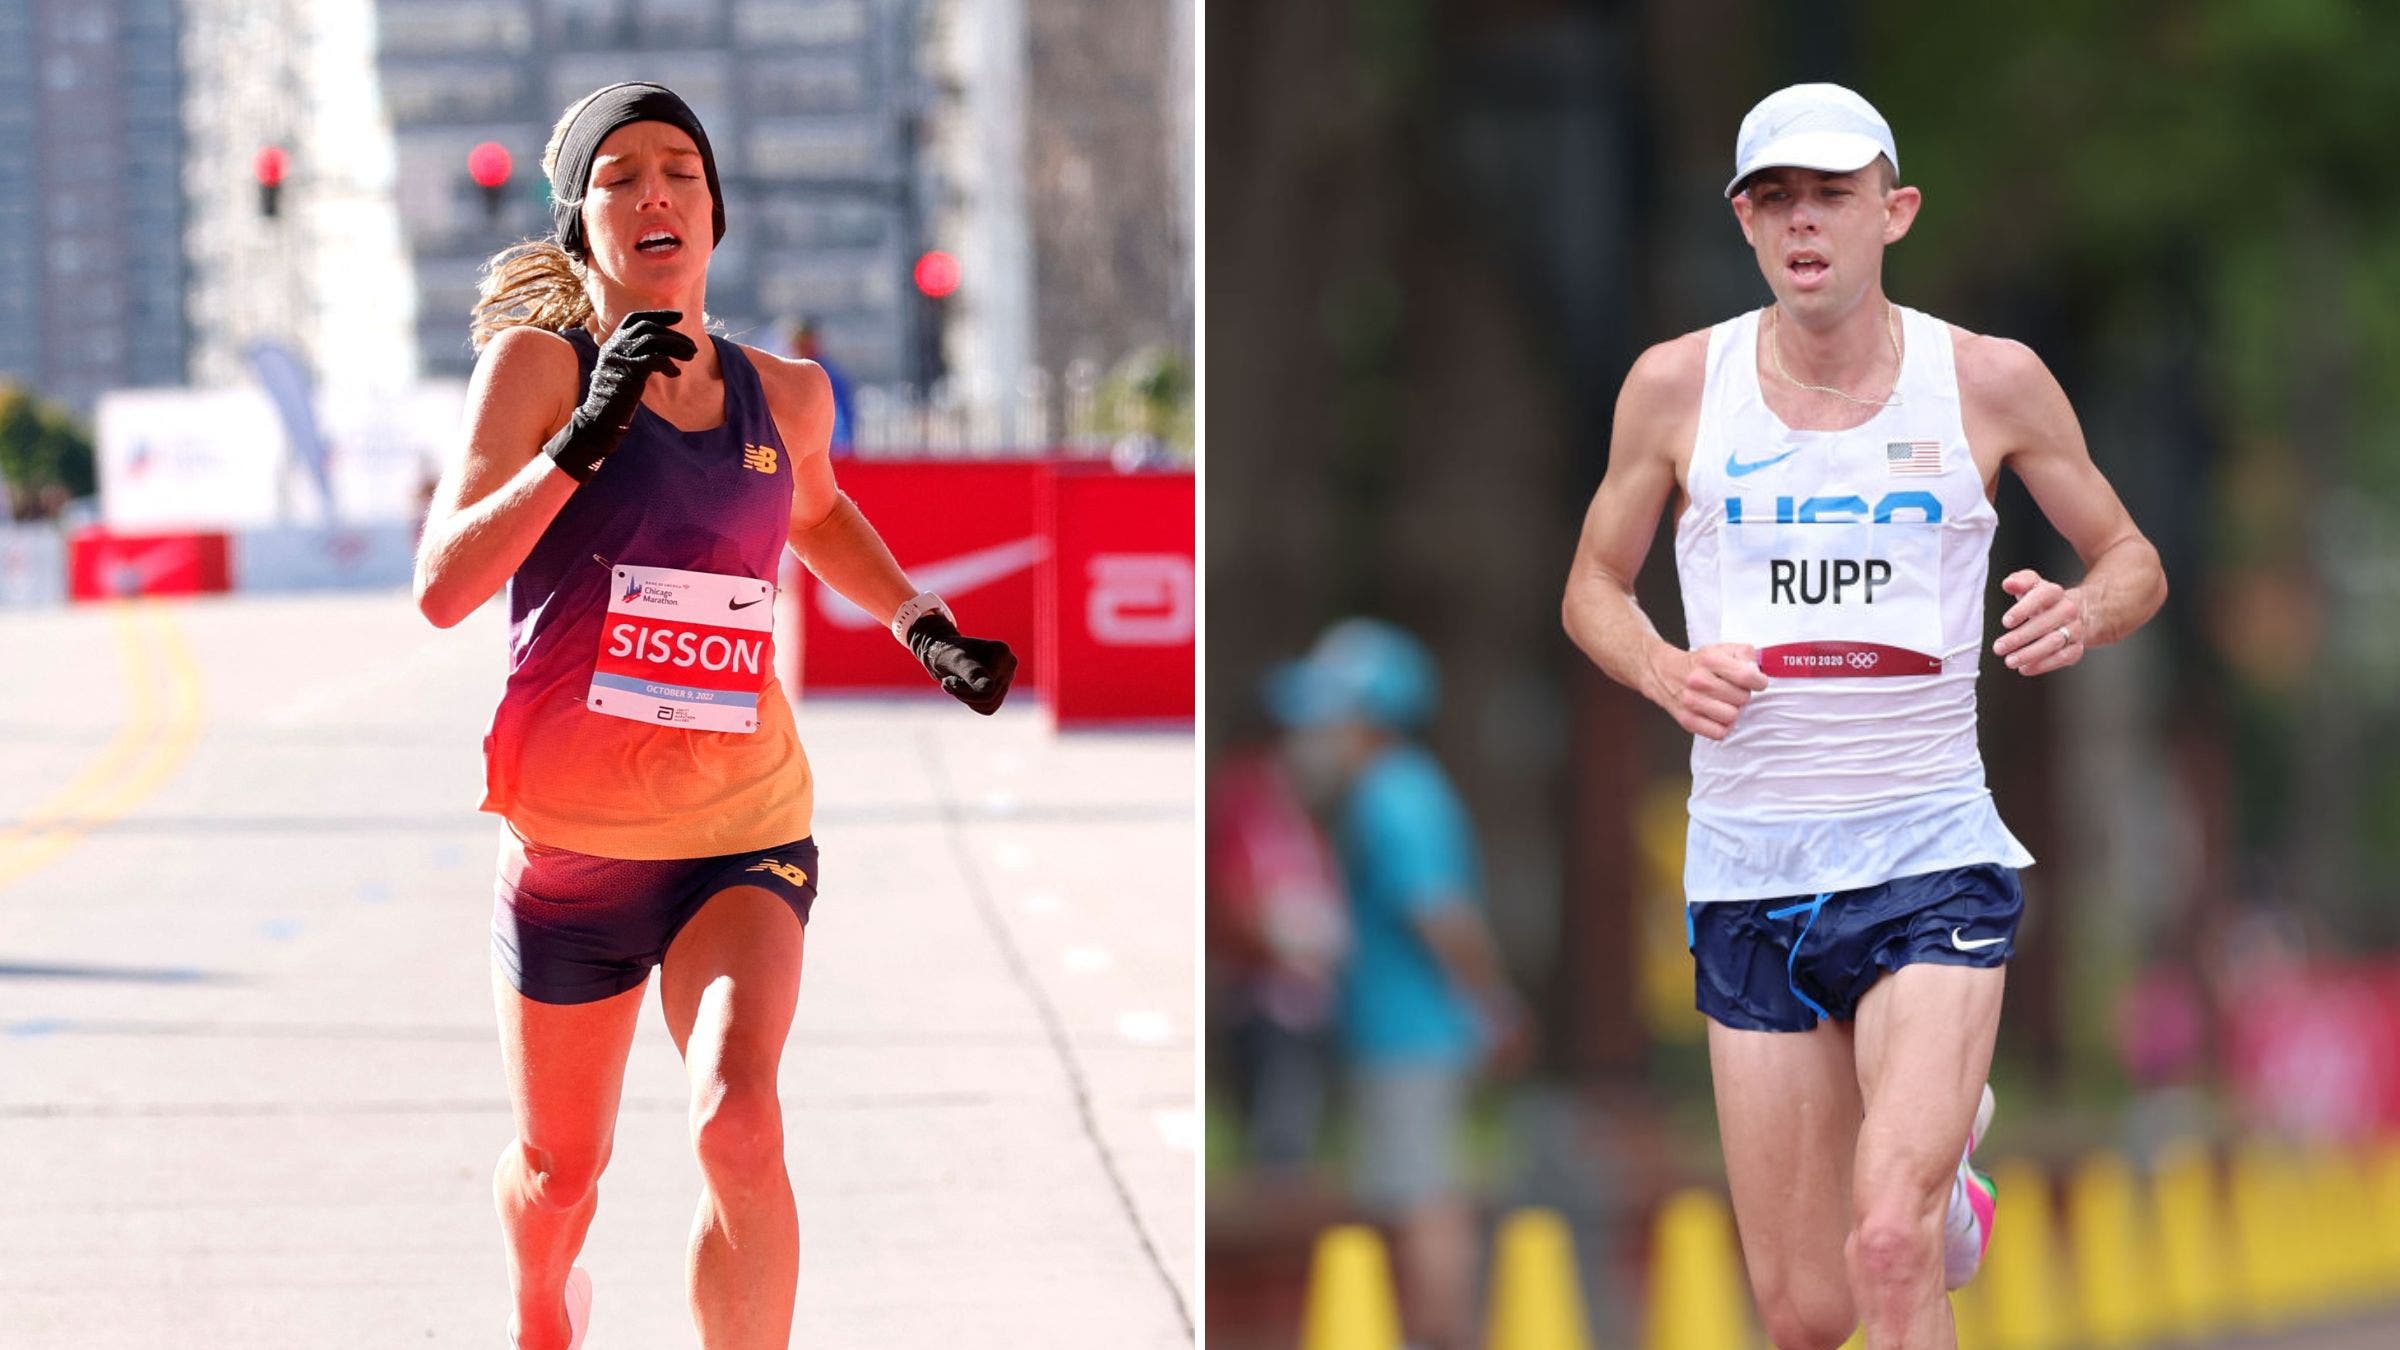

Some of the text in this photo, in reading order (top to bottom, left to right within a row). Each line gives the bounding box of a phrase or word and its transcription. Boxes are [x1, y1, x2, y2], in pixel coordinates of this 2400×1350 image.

[1770, 560, 1892, 605] RUPP
[644, 586, 673, 599] Chicago
[643, 595, 678, 606] Marathon
[608, 623, 764, 675] SISSON
[1782, 655, 1843, 666] TOKYO 2020
[646, 685, 685, 698] OCTOBER
[695, 691, 714, 701] 2022
